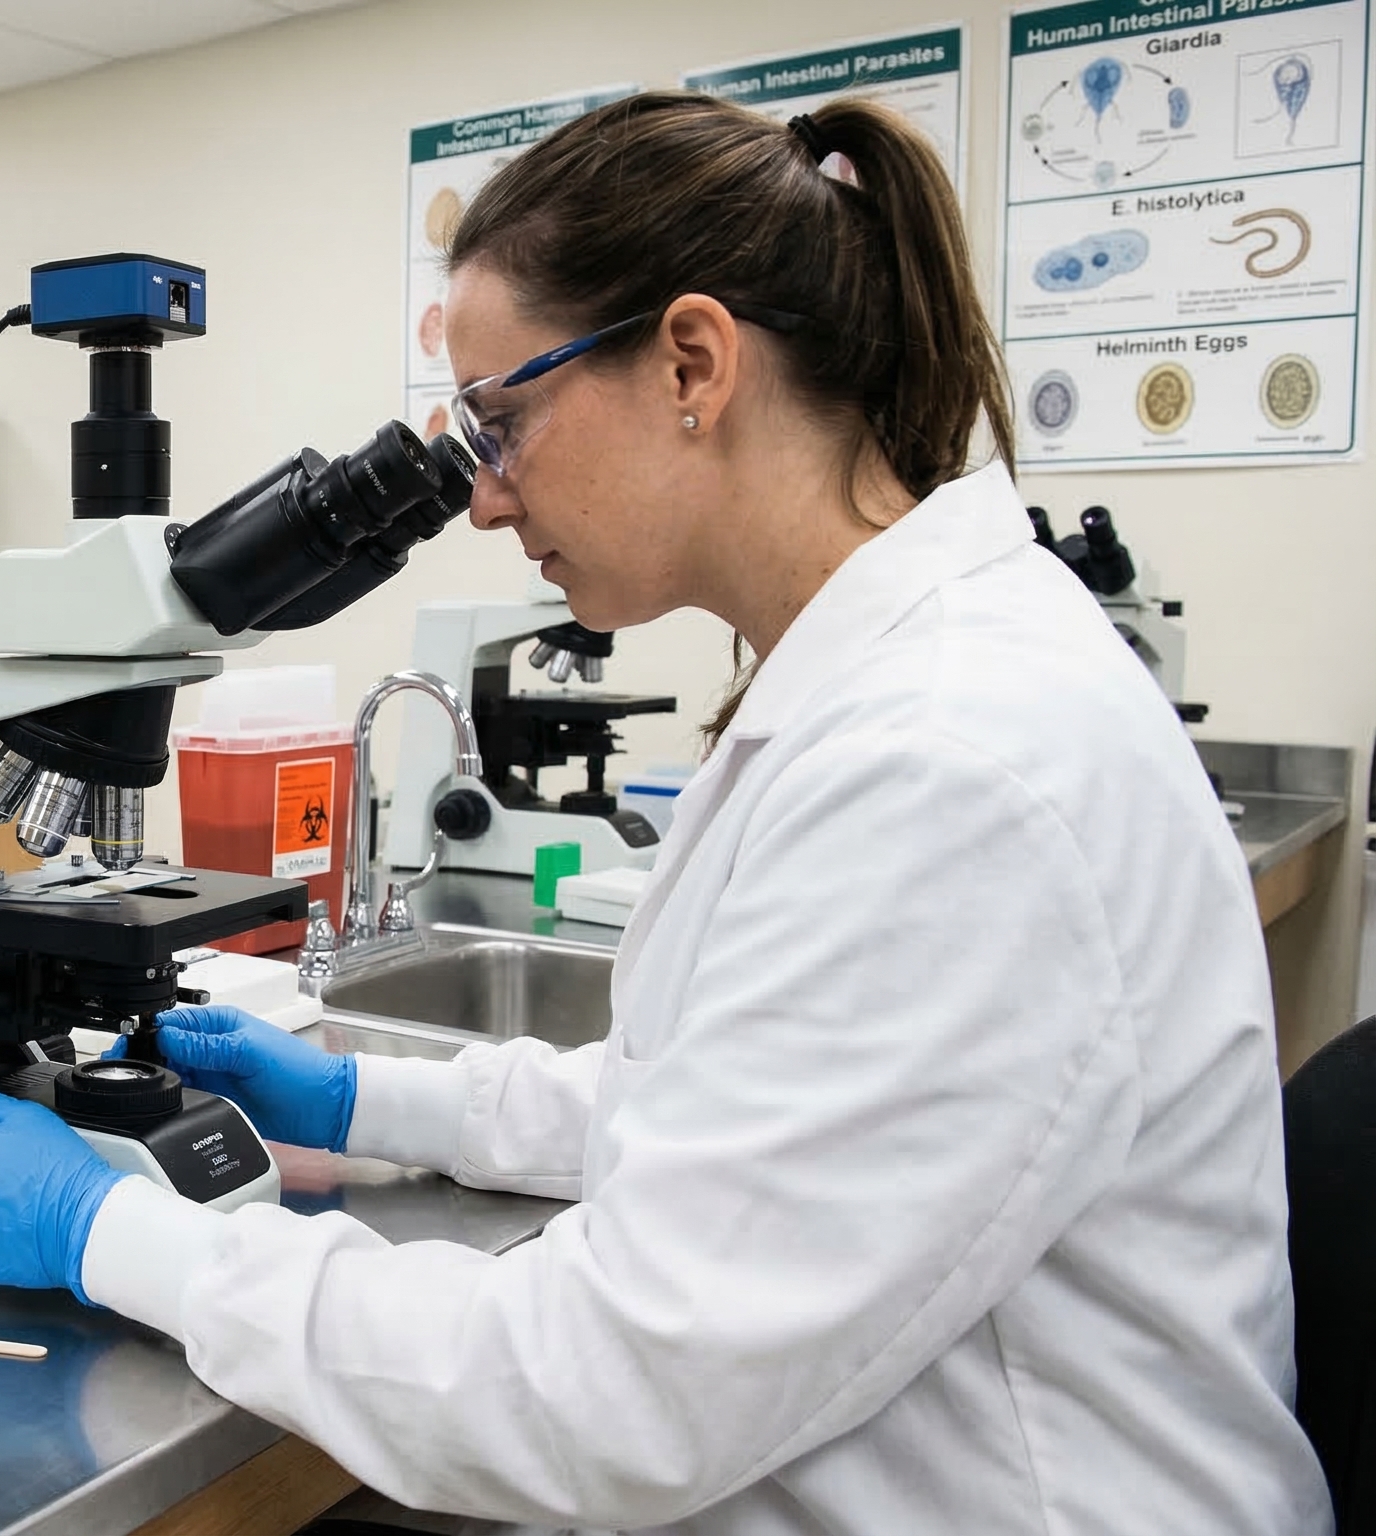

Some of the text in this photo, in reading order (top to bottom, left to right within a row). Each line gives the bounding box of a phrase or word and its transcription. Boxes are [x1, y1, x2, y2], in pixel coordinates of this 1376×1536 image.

[1027, 0, 1305, 47] Human Intestinal Paras
[1146, 31, 1222, 55] Giardia
[764, 58, 849, 88] Intestinal
[854, 45, 945, 72] Parasites
[452, 103, 585, 137] Common Human
[436, 128, 507, 156] Intestinal
[1112, 189, 1245, 216] E. histolytica
[1097, 334, 1248, 357] Helminth Eggs
